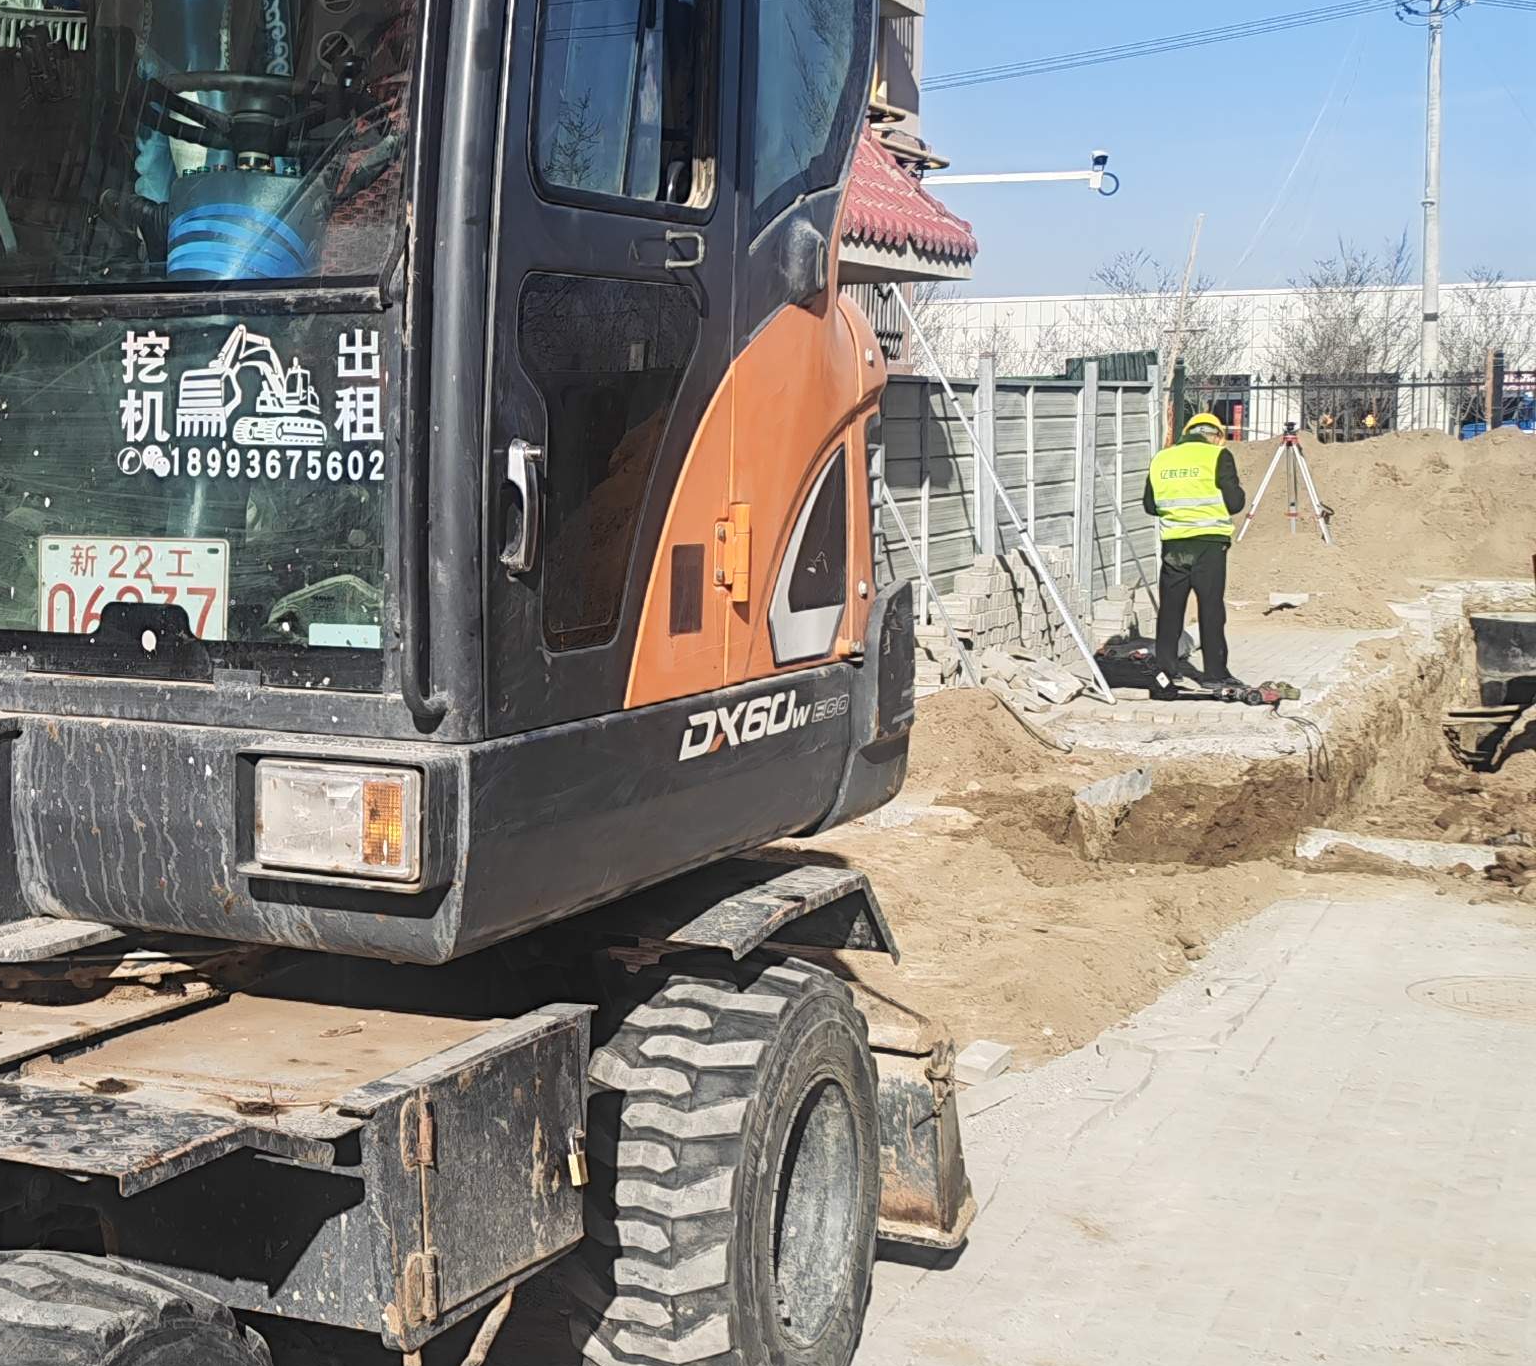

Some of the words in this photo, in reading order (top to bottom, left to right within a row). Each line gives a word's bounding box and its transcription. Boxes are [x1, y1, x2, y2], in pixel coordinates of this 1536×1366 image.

[119, 330, 171, 443] 挖机
[334, 328, 385, 443] 出租
[169, 447, 385, 481] 18993675602
[47, 583, 217, 640] 067
[811, 694, 850, 723] ECO
